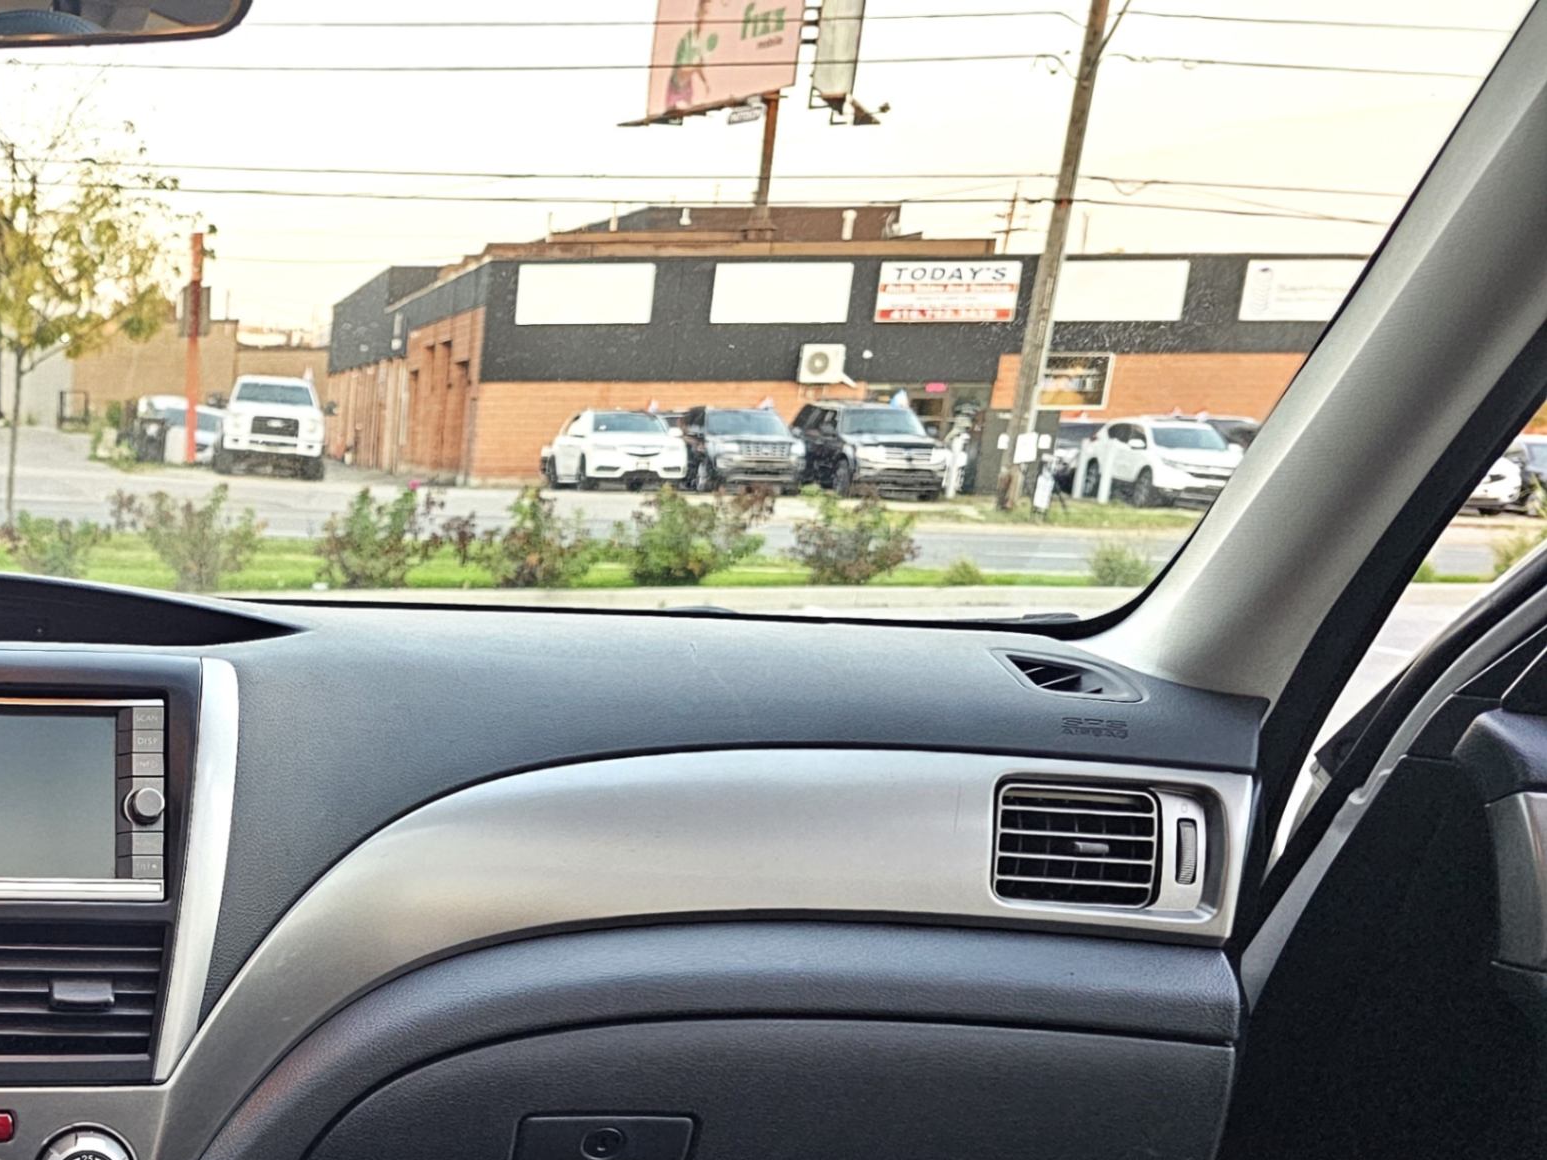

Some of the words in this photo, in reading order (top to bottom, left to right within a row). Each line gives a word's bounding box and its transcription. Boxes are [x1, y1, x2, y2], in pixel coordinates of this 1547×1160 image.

[740, 2, 786, 40] fizz
[895, 267, 1007, 281] TODAY'S
[137, 737, 158, 745] DISP
